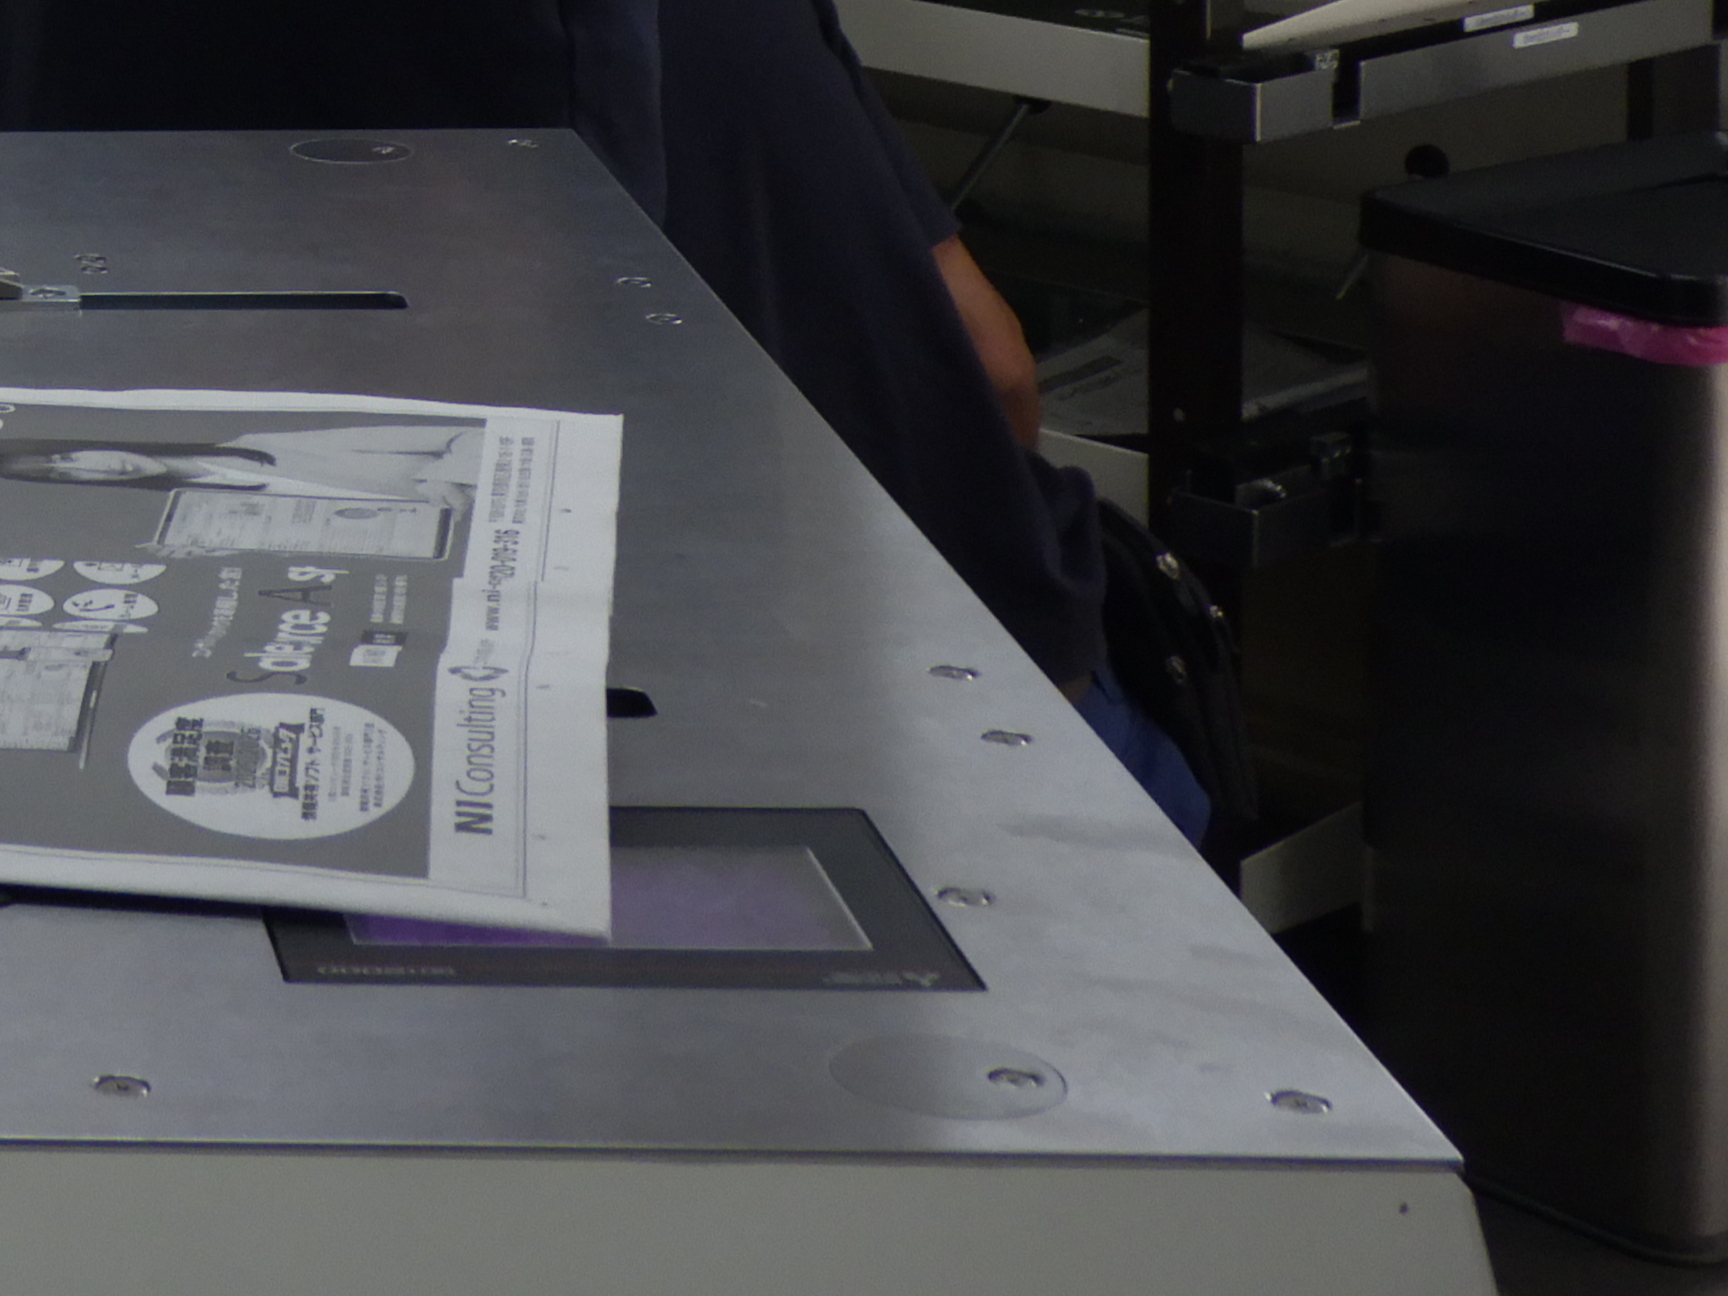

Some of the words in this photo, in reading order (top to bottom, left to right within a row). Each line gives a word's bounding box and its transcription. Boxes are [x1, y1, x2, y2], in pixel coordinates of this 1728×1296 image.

[164, 716, 205, 797] 顧客満足度
[202, 739, 235, 772] 調査
[450, 685, 508, 798] Consulting
[453, 799, 494, 836] NI
